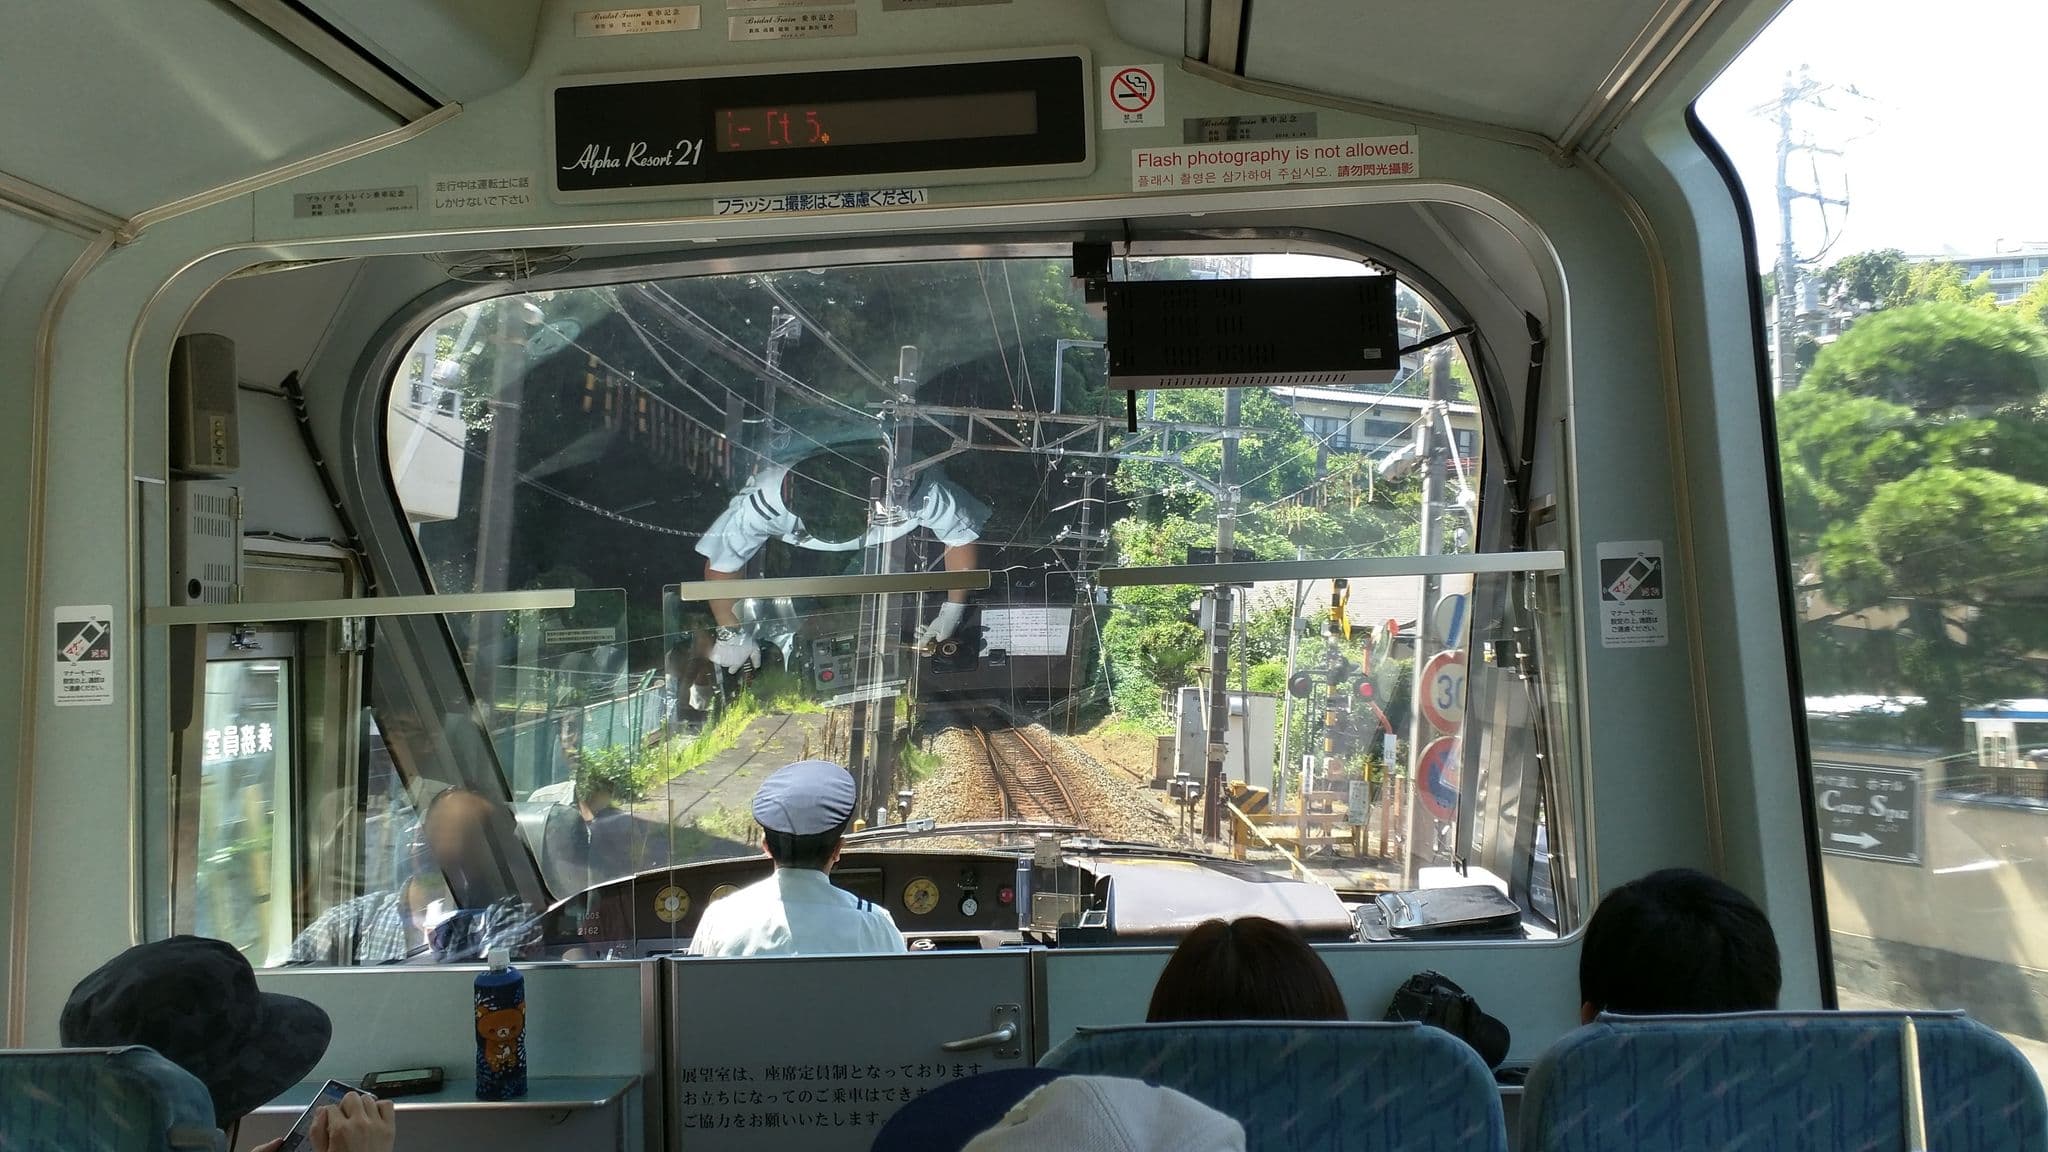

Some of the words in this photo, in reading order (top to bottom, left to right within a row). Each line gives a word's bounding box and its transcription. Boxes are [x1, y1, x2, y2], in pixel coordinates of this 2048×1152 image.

[562, 144, 621, 176] Alpha
[625, 141, 673, 167] Resort
[675, 139, 703, 166] 21
[1138, 153, 1182, 168] Flash
[1187, 147, 1290, 169] photography
[1296, 145, 1309, 160] is
[1315, 145, 1341, 159] not
[1346, 141, 1414, 157] allowed.
[436, 177, 529, 192] 走行中は運転士に話
[1138, 174, 1174, 187] 플래시
[1279, 166, 1332, 180] 주십시오.
[435, 194, 530, 208] しかけないで下さい
[718, 189, 924, 214] フラッシュ撮影はご遠慮ください
